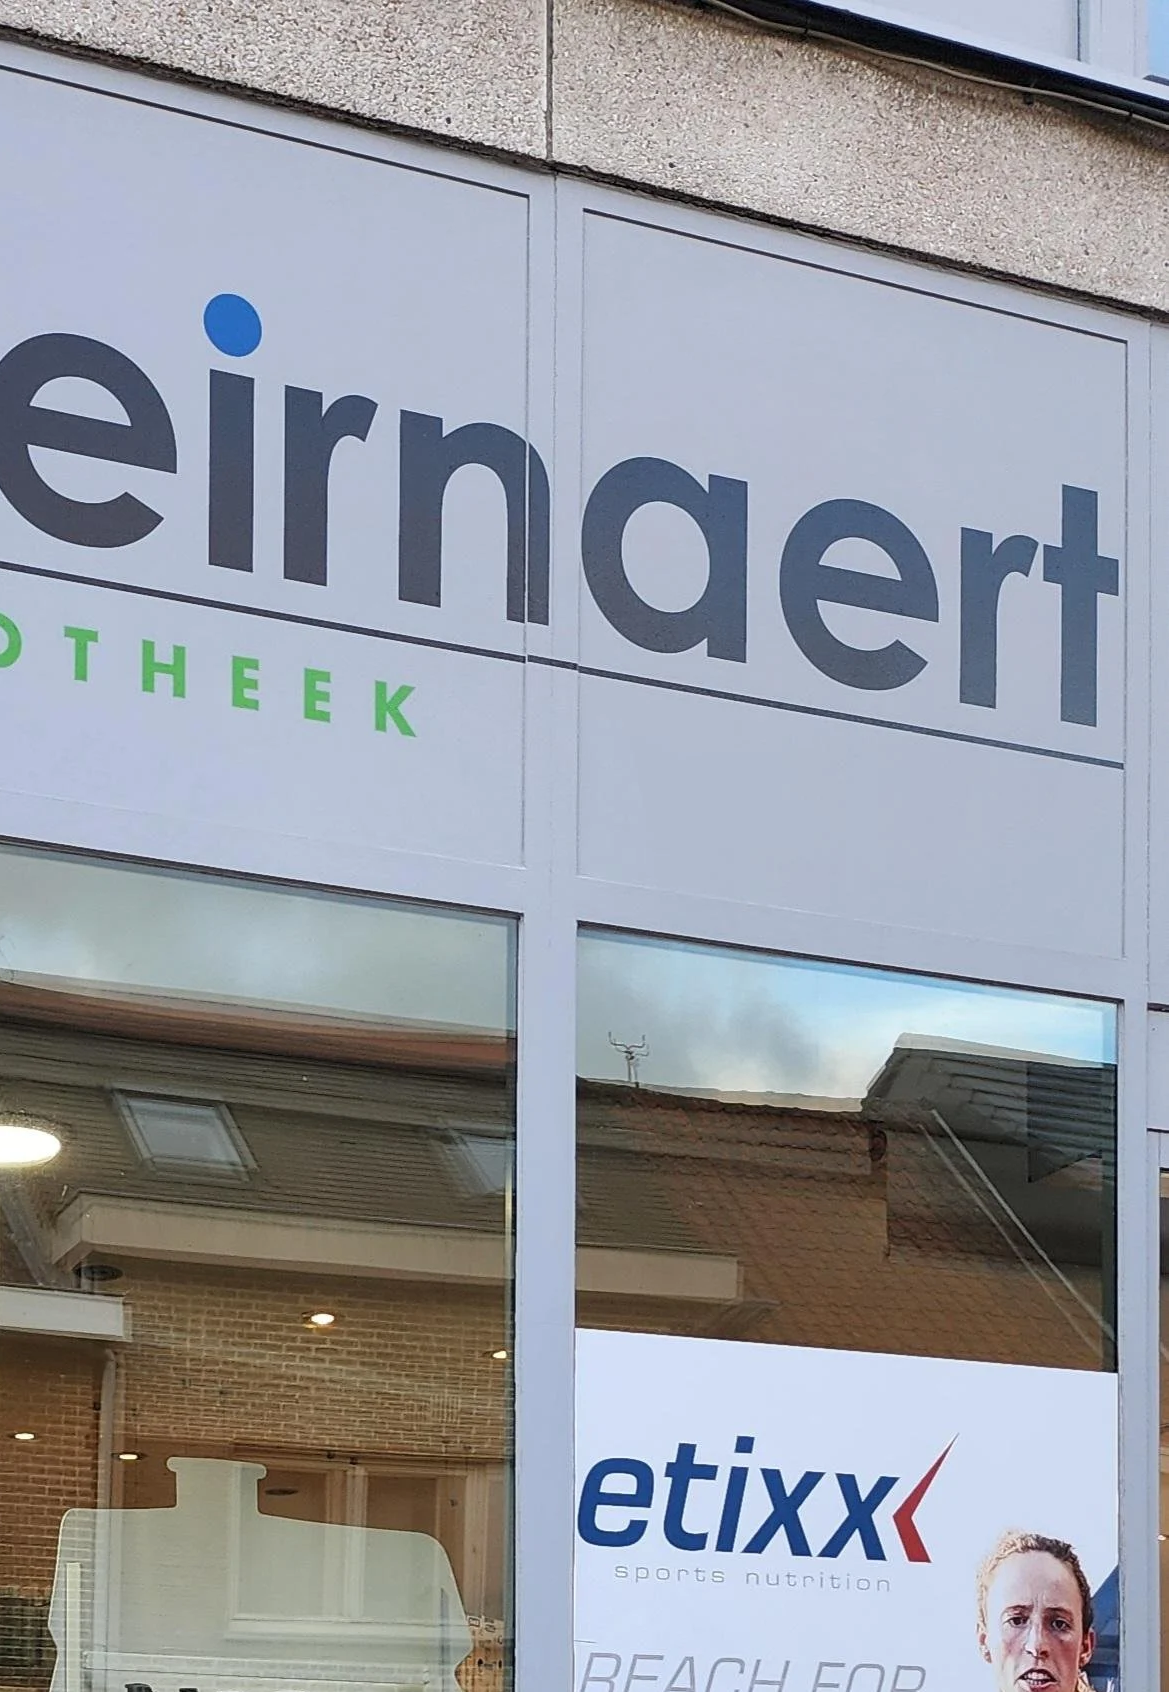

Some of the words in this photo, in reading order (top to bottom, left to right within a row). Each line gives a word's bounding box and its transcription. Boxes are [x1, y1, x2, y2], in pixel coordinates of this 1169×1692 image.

[577, 1435, 905, 1562] etixx
[614, 1565, 726, 1583] sports
[746, 1571, 891, 1592] nutrition
